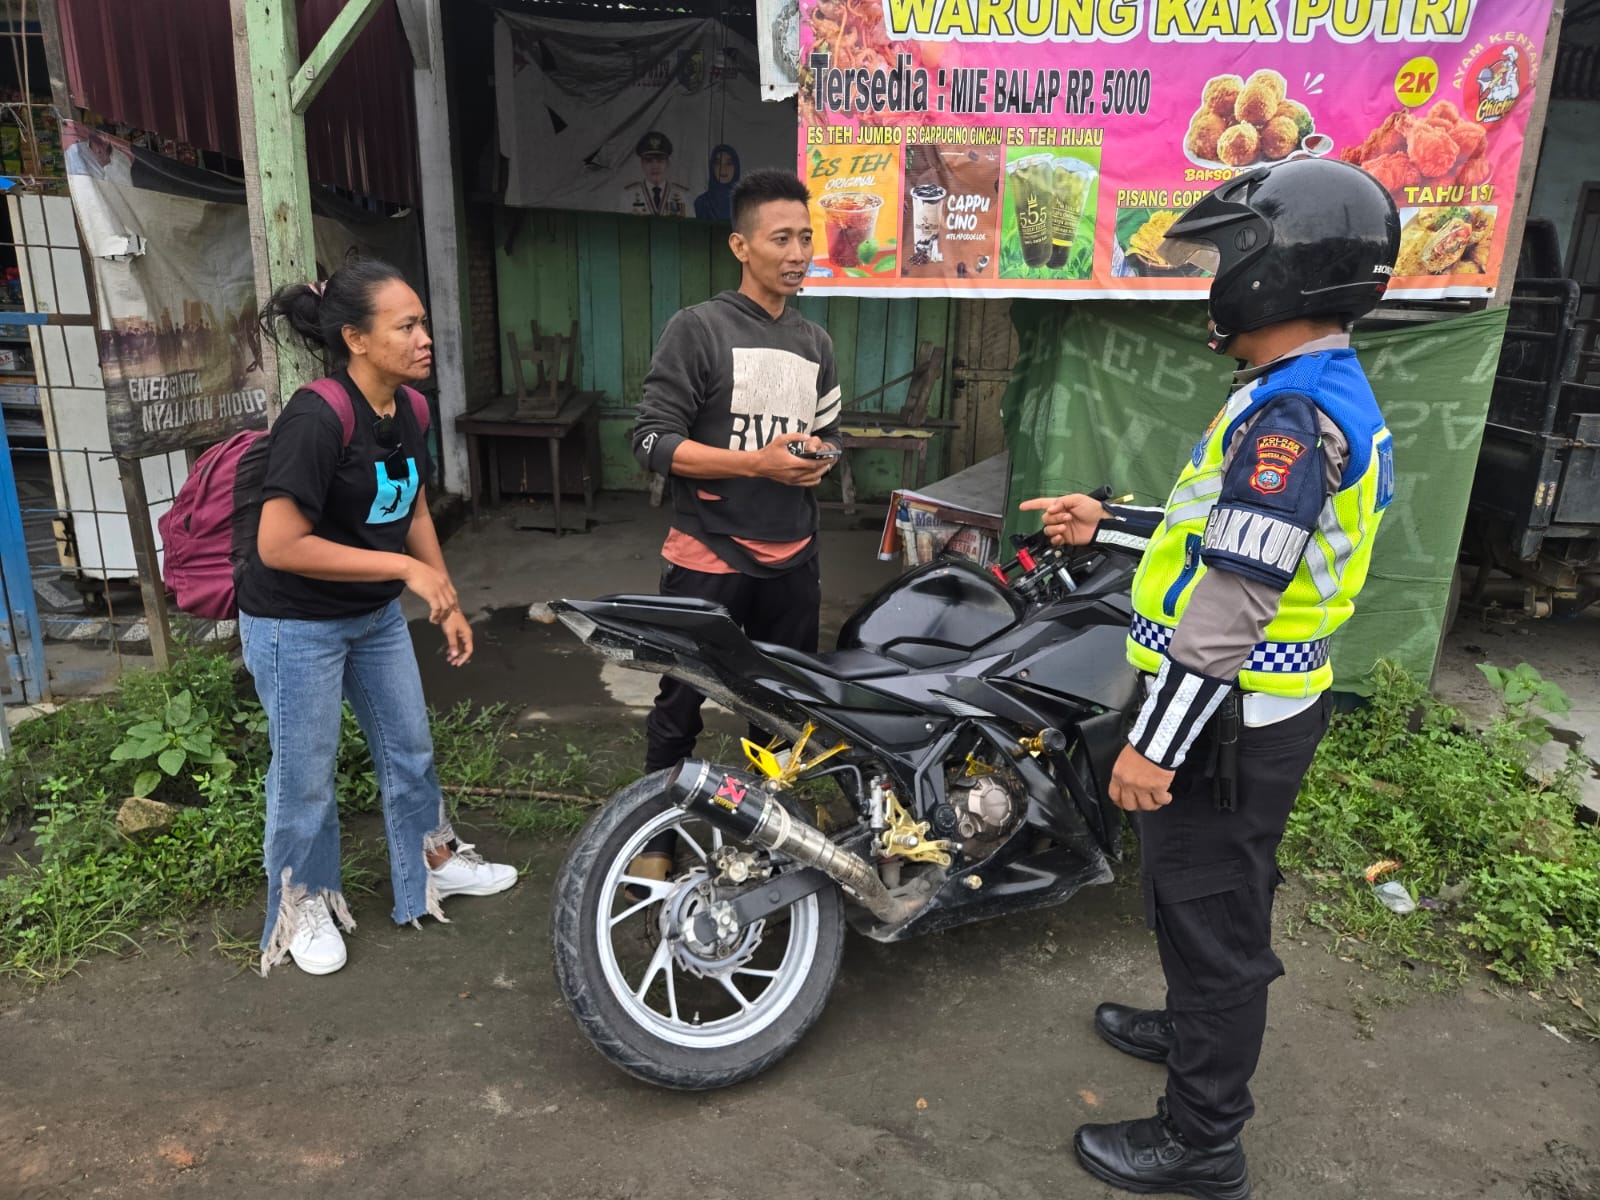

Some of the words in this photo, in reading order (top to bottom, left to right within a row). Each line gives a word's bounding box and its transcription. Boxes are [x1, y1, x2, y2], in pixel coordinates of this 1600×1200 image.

[891, 0, 1138, 36] WARUNG
[1154, 0, 1277, 36] KAK
[1292, 0, 1472, 37] PUTRI
[1453, 43, 1485, 89] AYAM
[810, 52, 928, 112] Tersedia
[951, 68, 989, 113] MIE
[994, 68, 1061, 114] BALAP
[1065, 69, 1095, 114] RP.
[1101, 68, 1151, 115] 5000
[1398, 71, 1436, 93] 2K
[807, 126, 824, 144] ES
[827, 126, 853, 144] TEH
[856, 126, 902, 144] JUMBO
[906, 126, 917, 144] ES
[919, 126, 968, 145] CAPPUCINO
[1006, 127, 1024, 145] ES
[1029, 127, 1058, 145] TEH
[1061, 127, 1104, 146] HIJAU
[811, 158, 842, 178] ES
[850, 152, 893, 174] TEH
[1184, 168, 1232, 181] BAKSO
[947, 194, 990, 212] CAPPU
[1117, 189, 1168, 207] PISANG
[1404, 185, 1465, 204] TAHU
[947, 212, 978, 230] CINO
[128, 376, 179, 402] ENERGI
[179, 372, 203, 397] KITA
[219, 388, 267, 418] HIDUP
